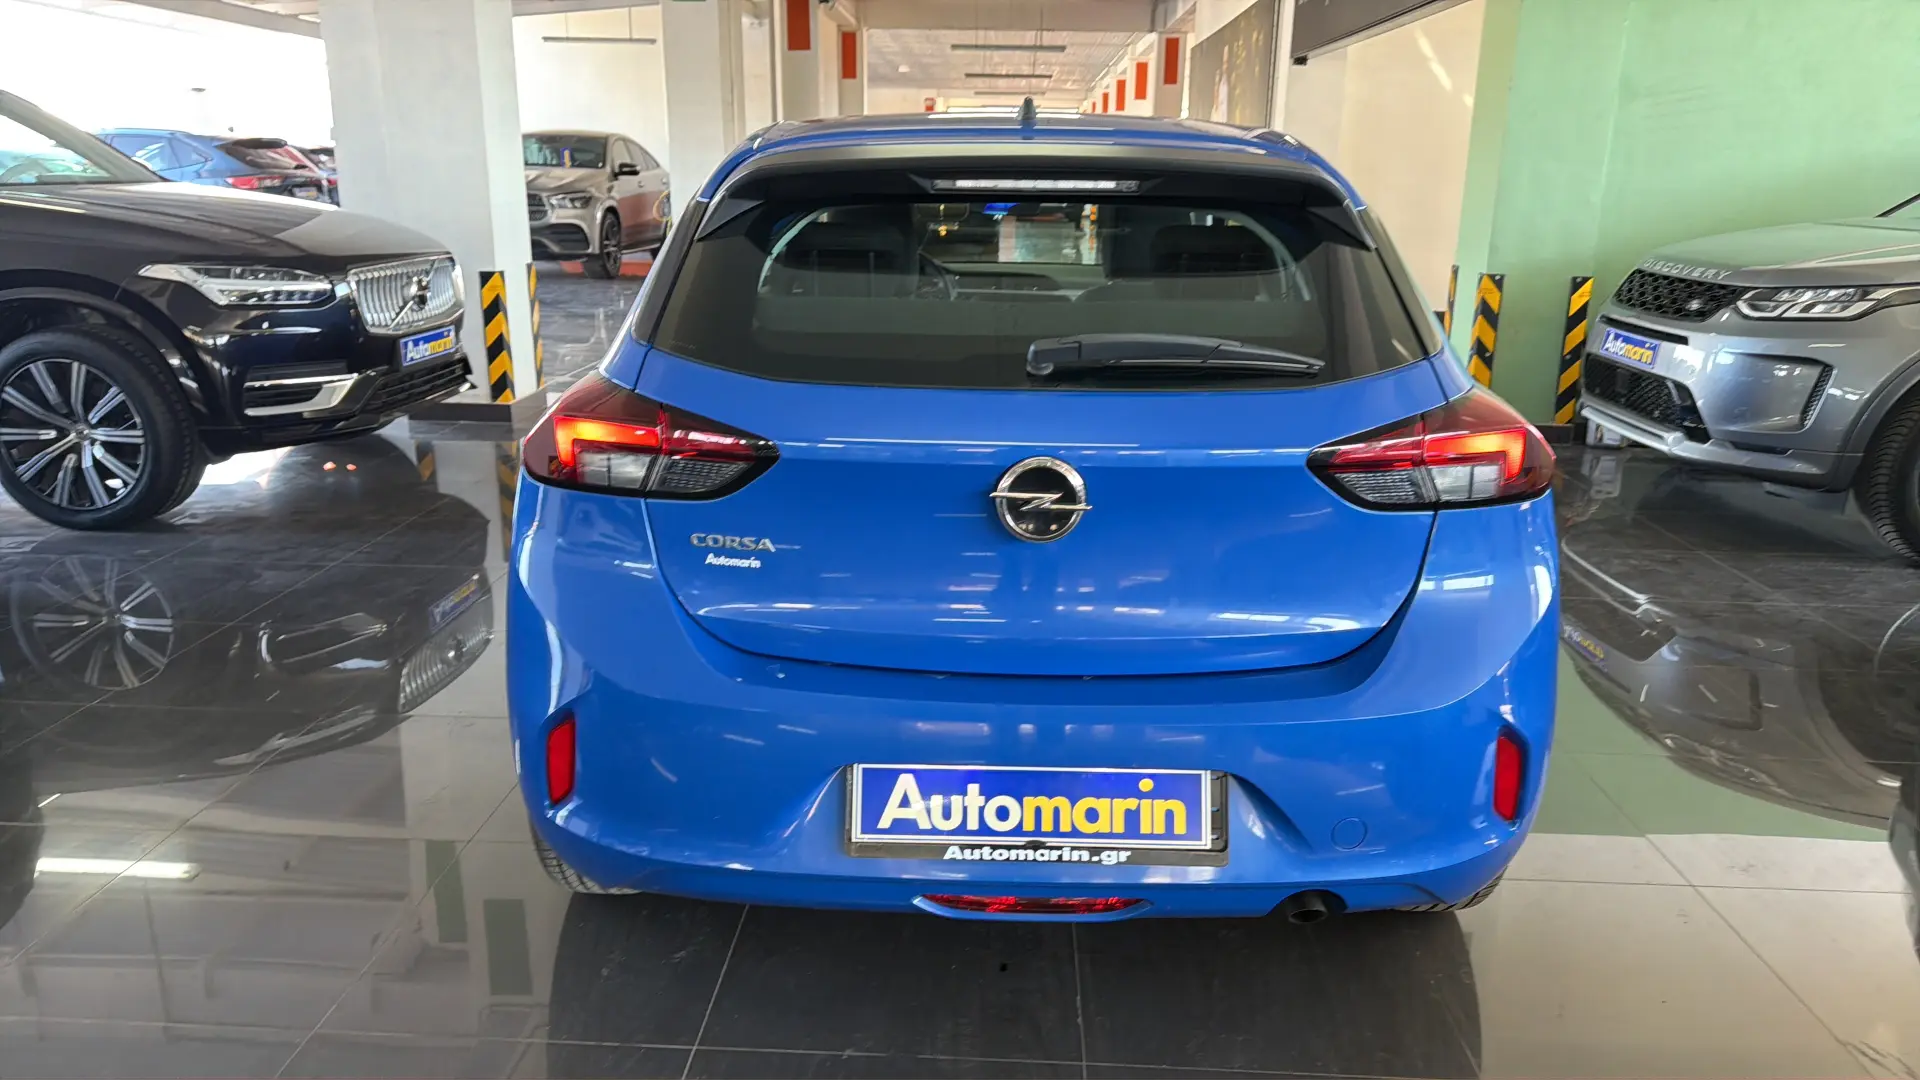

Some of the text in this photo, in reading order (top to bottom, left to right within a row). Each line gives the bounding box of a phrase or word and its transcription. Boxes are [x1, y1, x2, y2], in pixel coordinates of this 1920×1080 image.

[1643, 258, 1733, 280] DISCOVERY
[690, 533, 776, 552] CORSA
[704, 552, 761, 568] Automarin
[876, 772, 1188, 835] Automarin
[943, 845, 1131, 865] Automarin.gr
